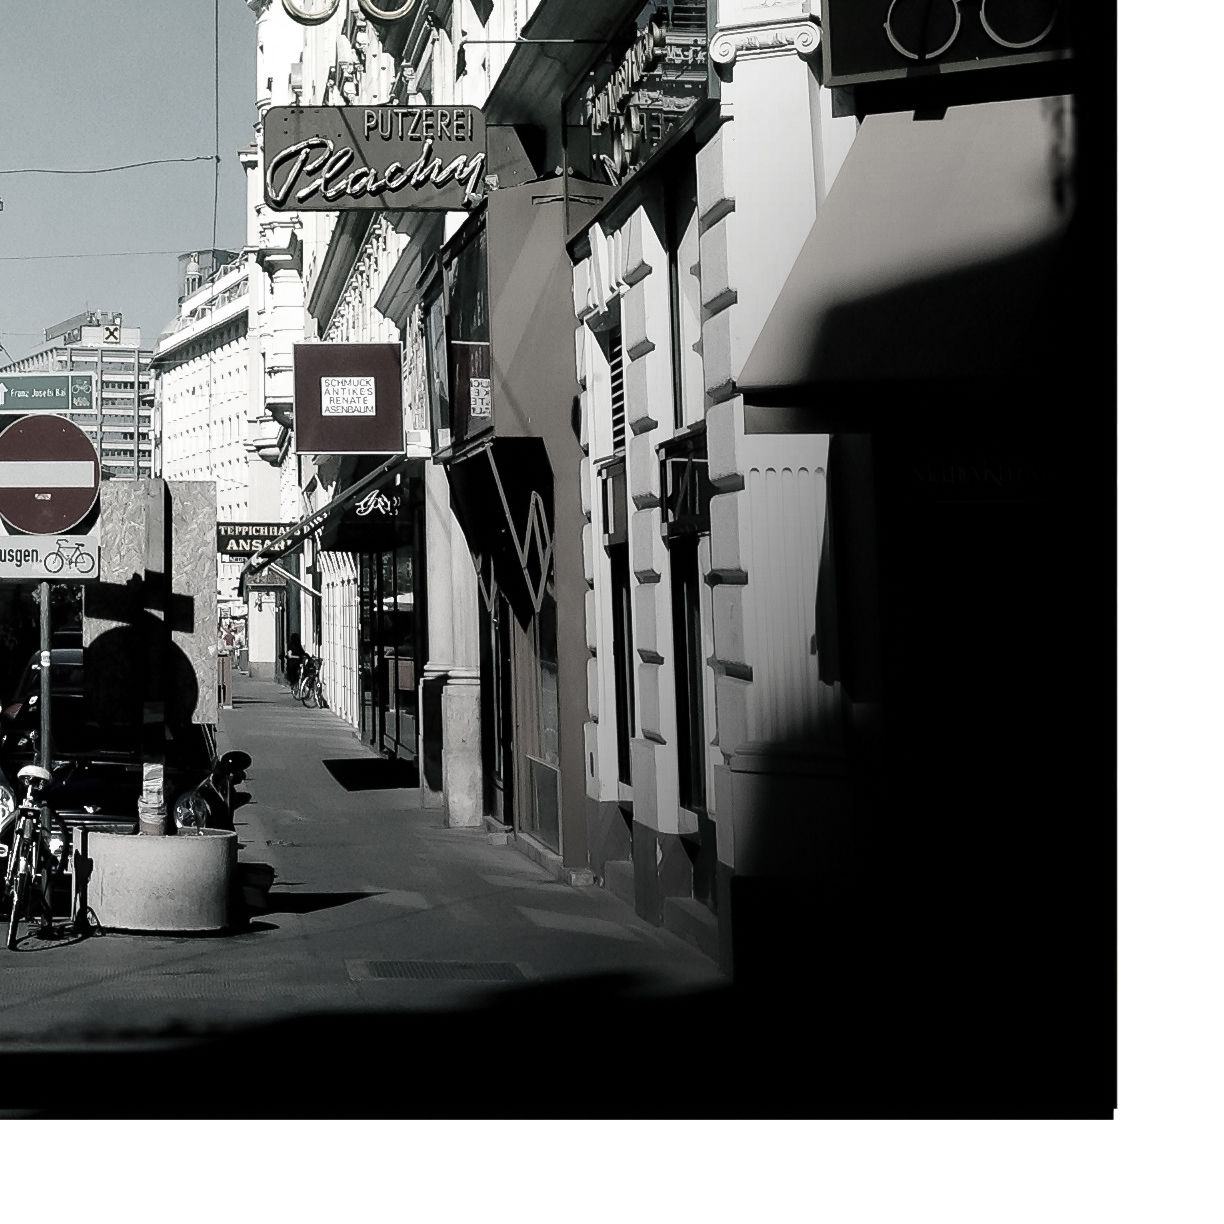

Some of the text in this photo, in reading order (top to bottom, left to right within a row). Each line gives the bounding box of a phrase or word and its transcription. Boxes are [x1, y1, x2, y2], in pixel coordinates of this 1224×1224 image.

[363, 109, 474, 140] PUTZEREI
[266, 137, 486, 207] Plachy
[324, 378, 373, 387] SCHMUCK
[324, 387, 374, 396] ANTIKES
[329, 396, 369, 405] RENATE
